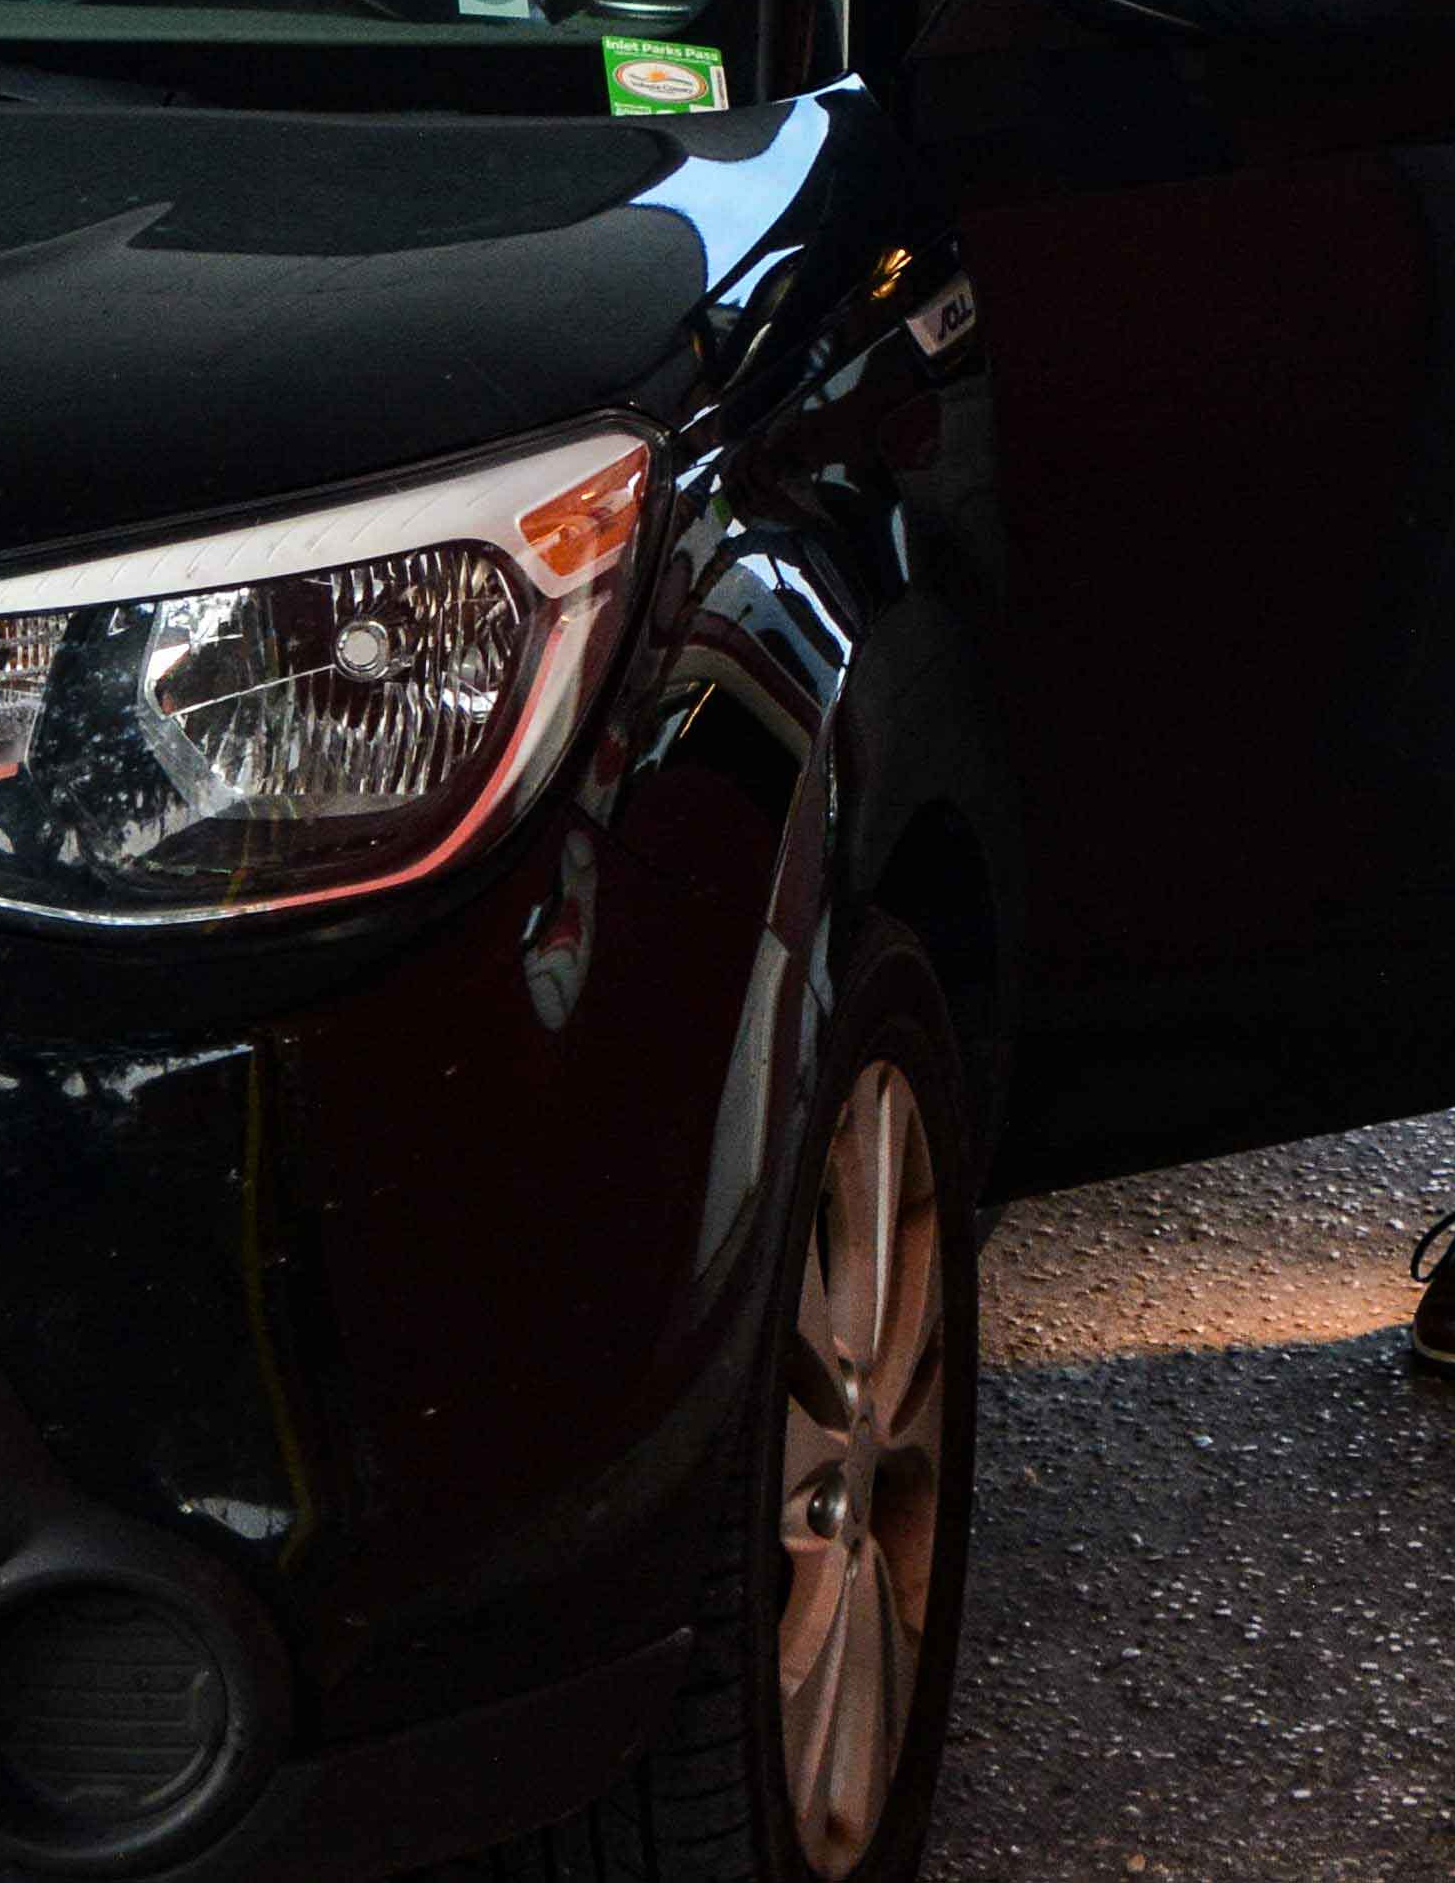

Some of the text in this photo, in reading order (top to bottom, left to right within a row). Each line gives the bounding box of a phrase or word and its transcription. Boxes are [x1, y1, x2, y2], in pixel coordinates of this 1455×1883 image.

[606, 38, 719, 61] Inlet Parks Pass
